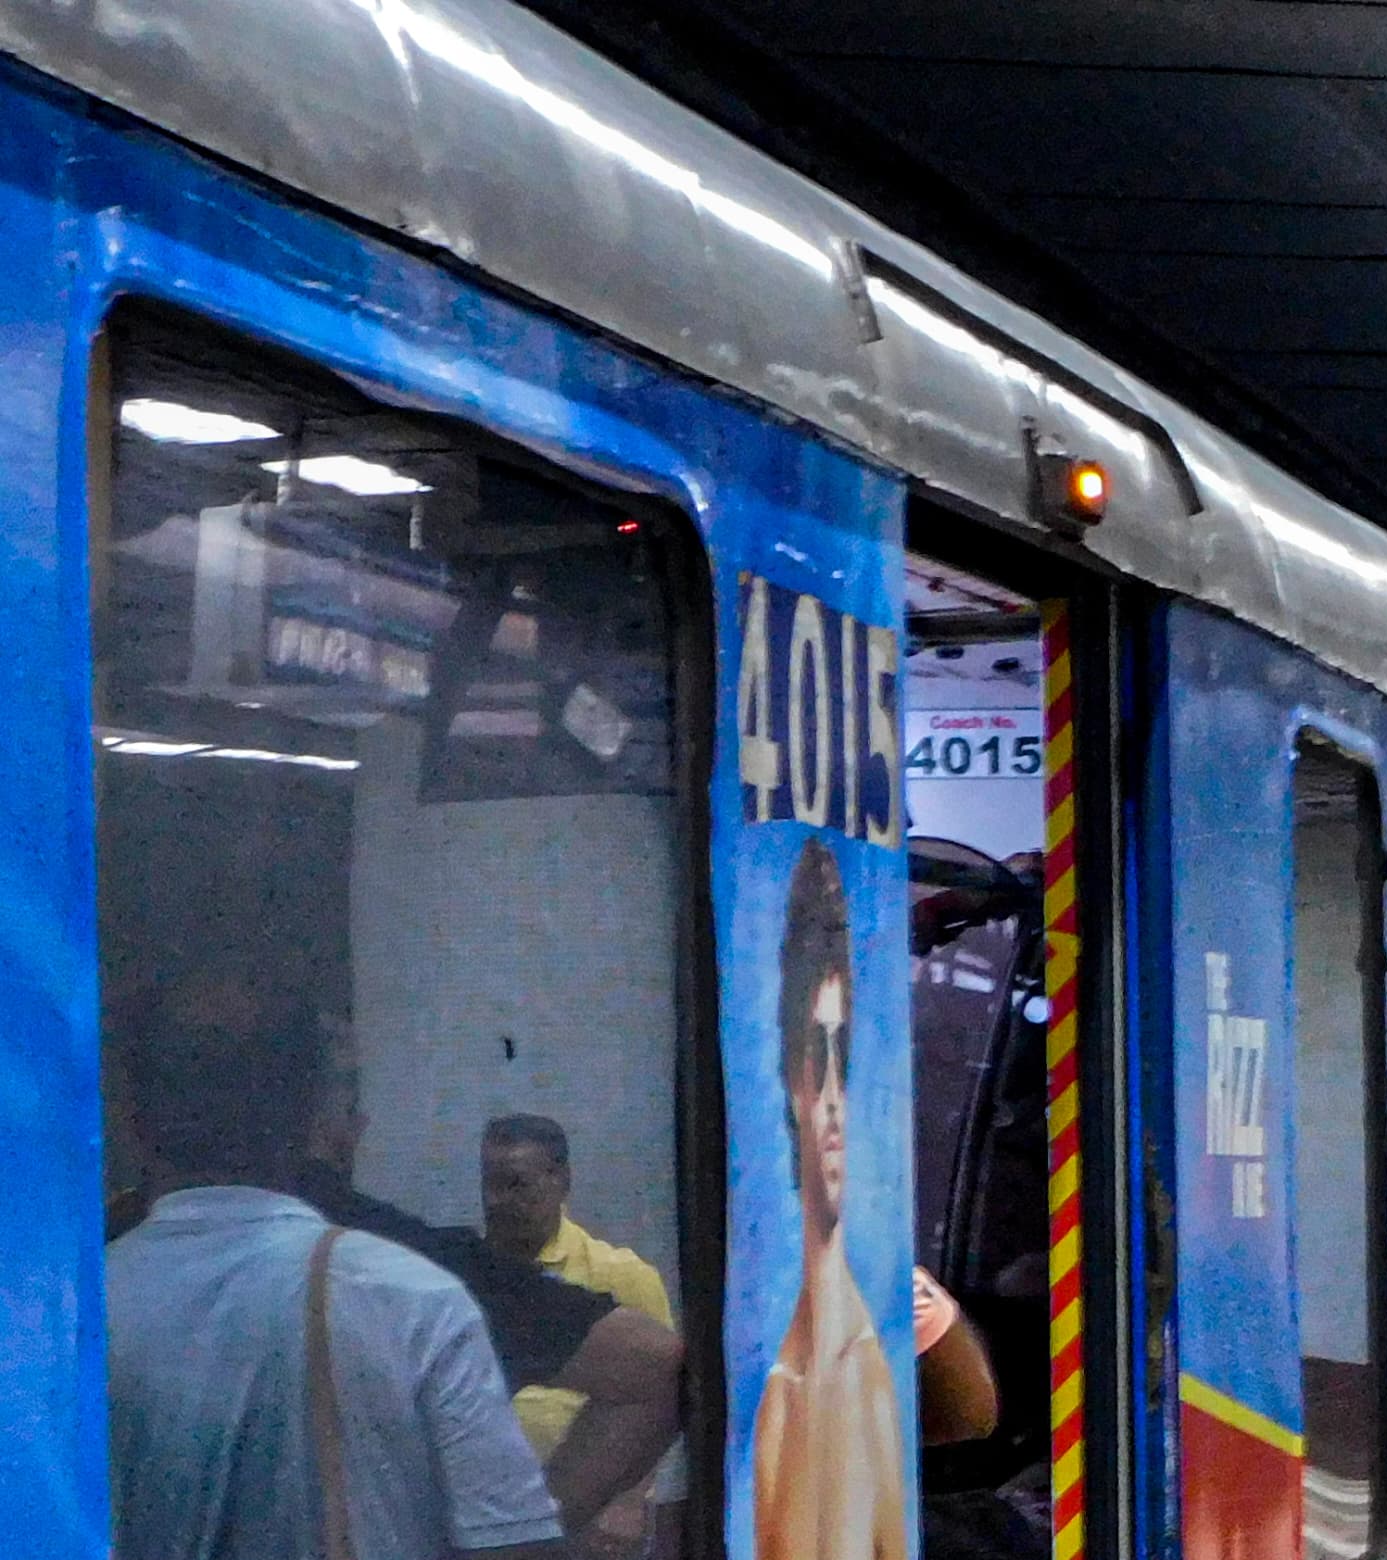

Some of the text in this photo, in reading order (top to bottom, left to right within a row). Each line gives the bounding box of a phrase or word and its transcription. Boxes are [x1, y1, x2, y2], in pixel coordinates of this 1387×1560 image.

[737, 575, 898, 848] 4015
[929, 715, 983, 729] Coach
[904, 735, 1041, 774] 4015
